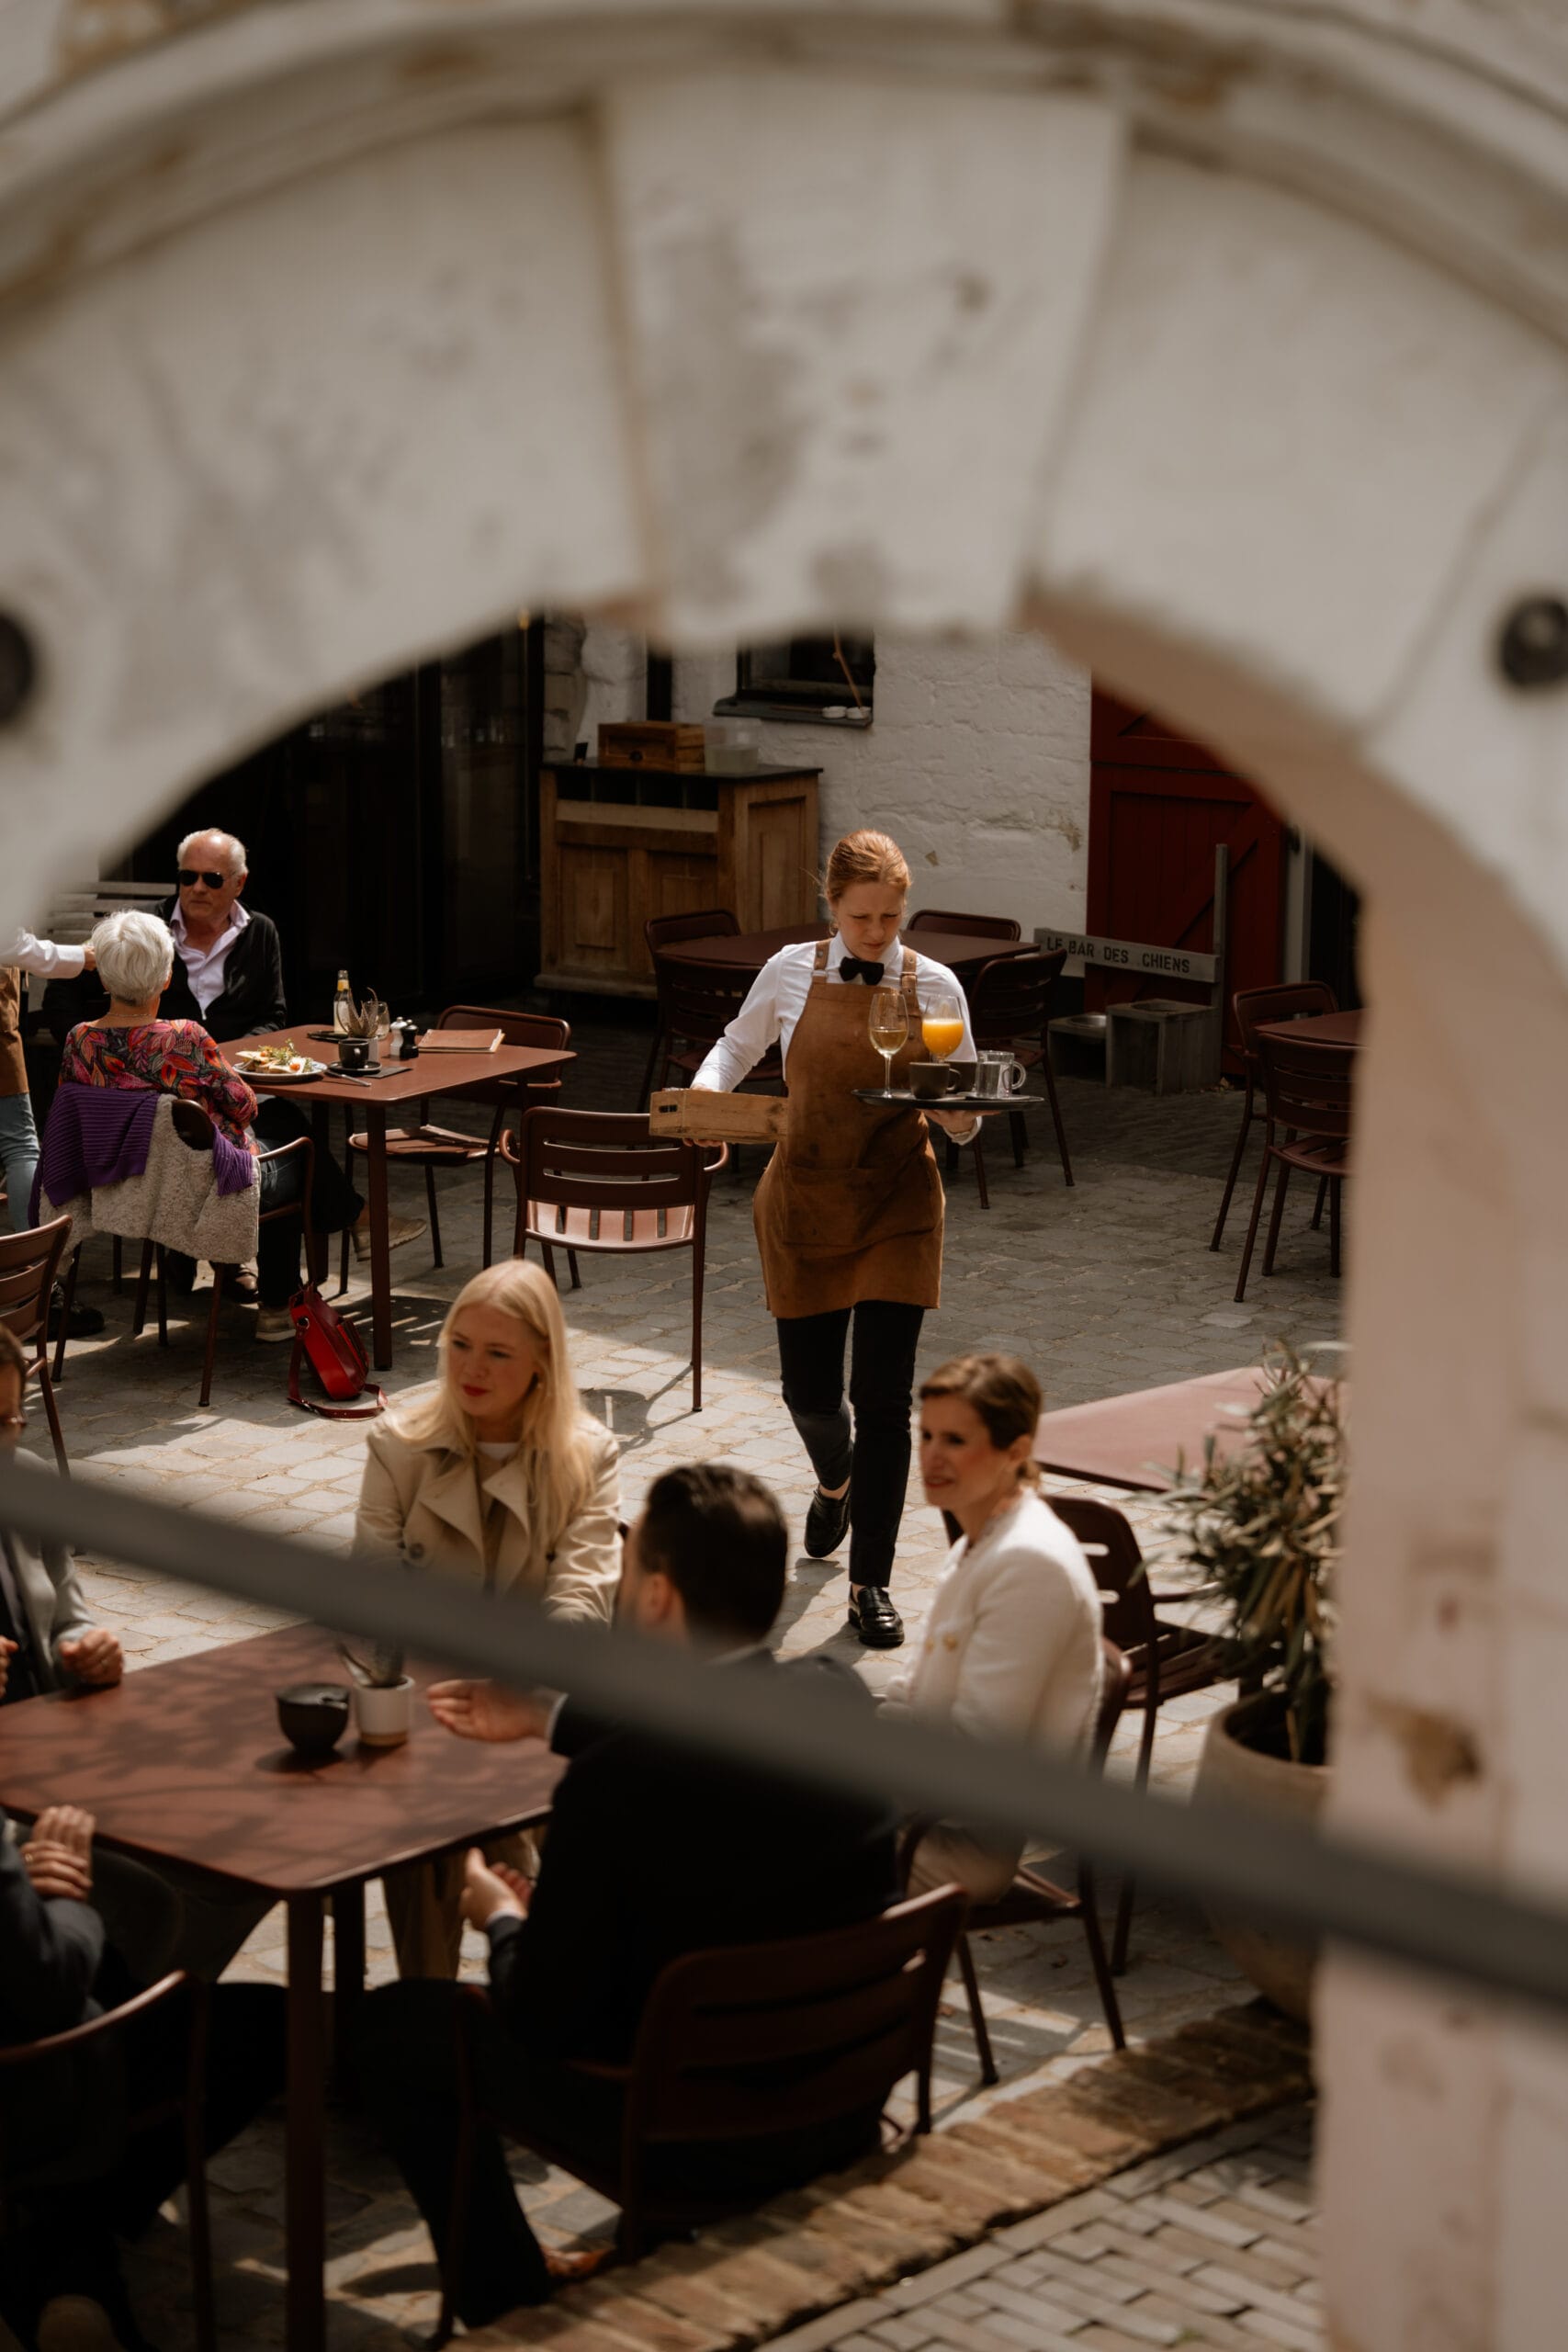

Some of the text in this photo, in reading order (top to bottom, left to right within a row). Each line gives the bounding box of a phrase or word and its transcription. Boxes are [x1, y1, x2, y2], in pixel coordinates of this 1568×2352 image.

[1068, 940, 1094, 957] BAR
[1104, 946, 1128, 964] DES
[1142, 953, 1190, 973] CHIENS
